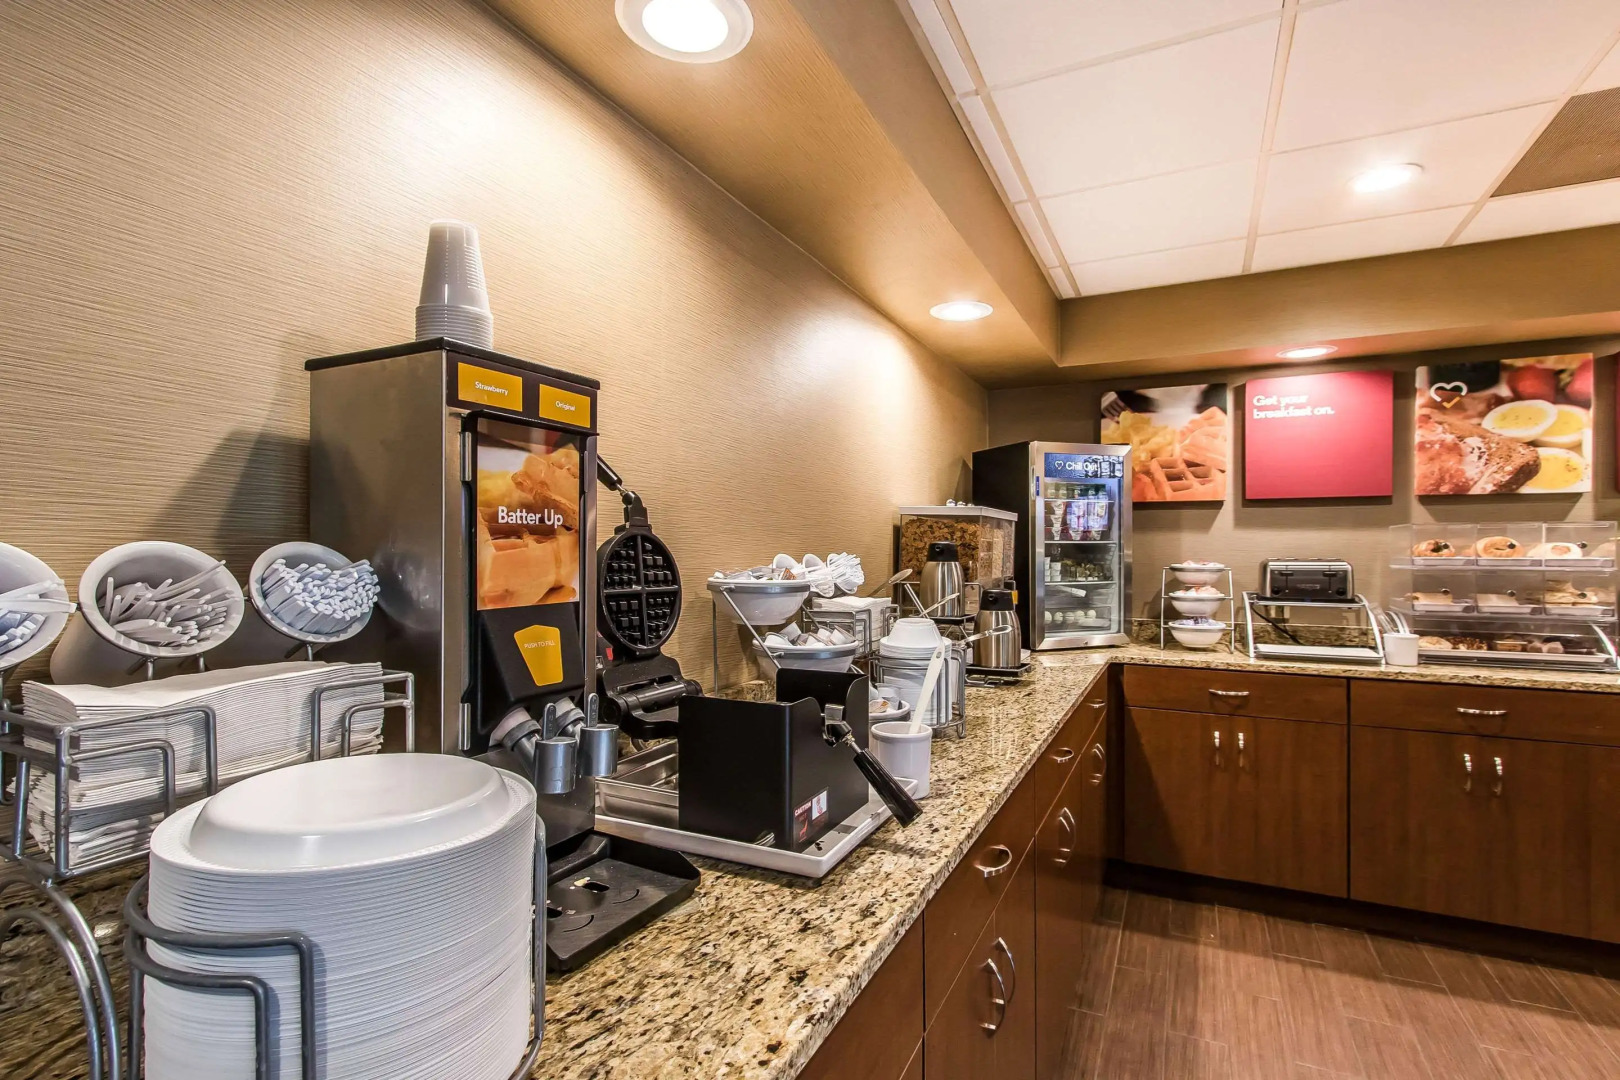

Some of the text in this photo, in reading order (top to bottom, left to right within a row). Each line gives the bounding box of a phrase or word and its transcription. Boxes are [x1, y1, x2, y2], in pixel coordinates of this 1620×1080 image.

[475, 381, 509, 396] Strawberry
[555, 401, 576, 412] Original
[1253, 395, 1309, 411] Get your
[1253, 406, 1335, 419] breakfast on.
[1065, 461, 1098, 471] Chill Out
[498, 506, 563, 529] Batter Up
[794, 800, 812, 817] CAUTION
